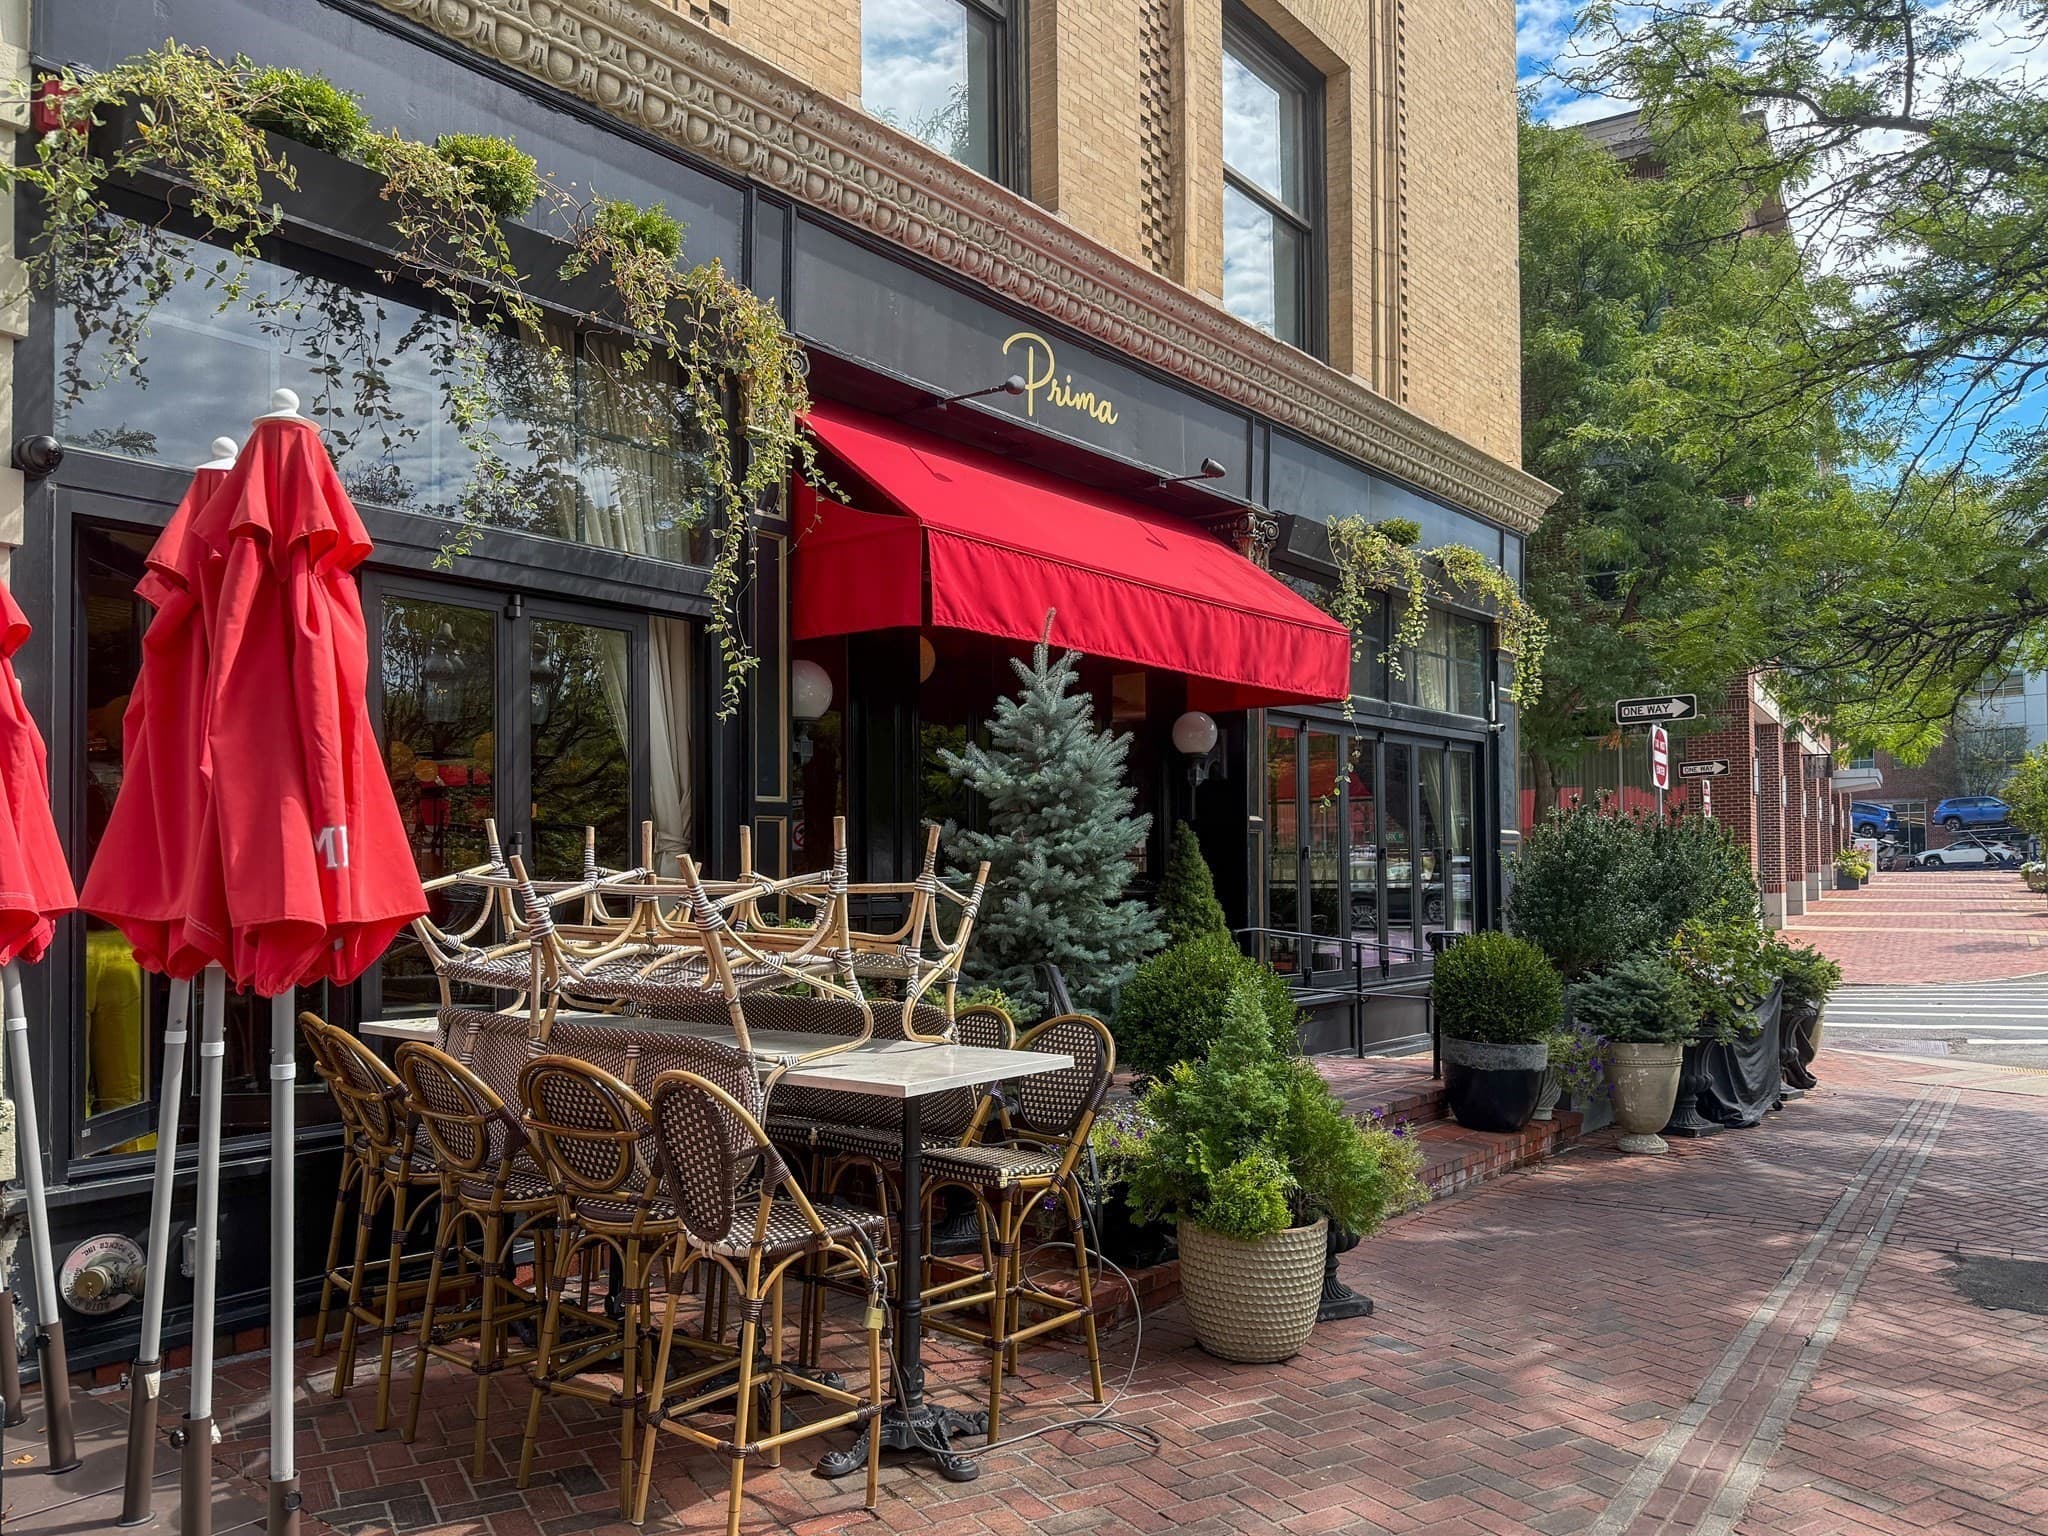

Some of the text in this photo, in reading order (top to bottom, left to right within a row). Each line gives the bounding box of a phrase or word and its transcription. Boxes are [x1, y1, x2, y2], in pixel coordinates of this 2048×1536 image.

[1003, 332, 1118, 424] Prima
[1623, 703, 1670, 716] ONE WAY
